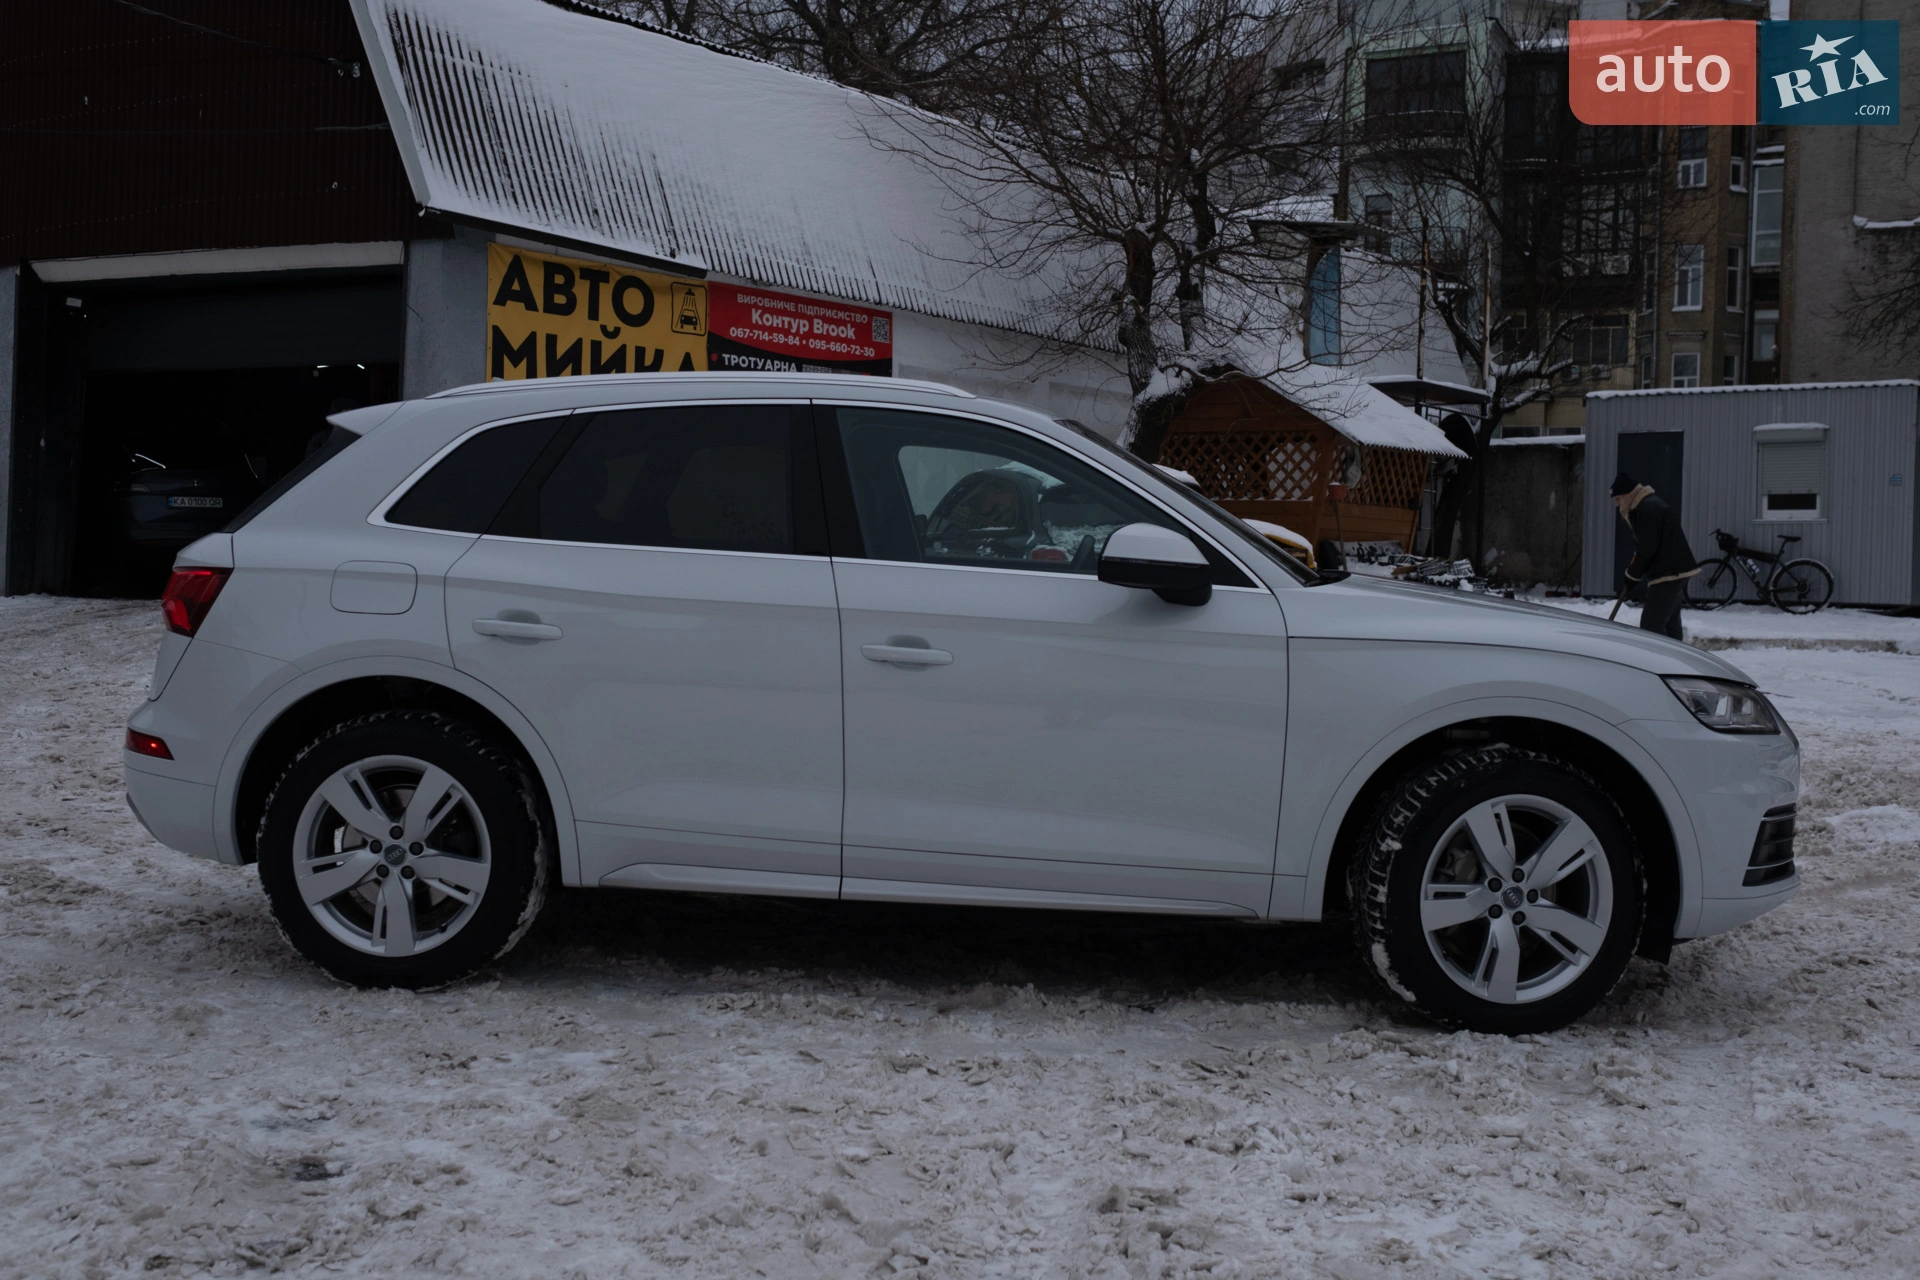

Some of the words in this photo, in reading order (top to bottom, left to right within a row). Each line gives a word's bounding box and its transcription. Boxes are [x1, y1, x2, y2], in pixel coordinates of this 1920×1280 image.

[492, 254, 655, 327] АВТО
[737, 293, 796, 312] ВИРОБНИЧЕ
[797, 303, 869, 324] ПІДПРИЄМСТВО
[751, 308, 809, 335] Контур
[813, 318, 856, 340] Brook
[729, 327, 800, 346] 067-714-59-84
[808, 339, 875, 357] 095-660-72-30
[722, 353, 798, 372] ТРОТУАРНА
[173, 497, 185, 506] KA
[187, 498, 207, 506] 0100
